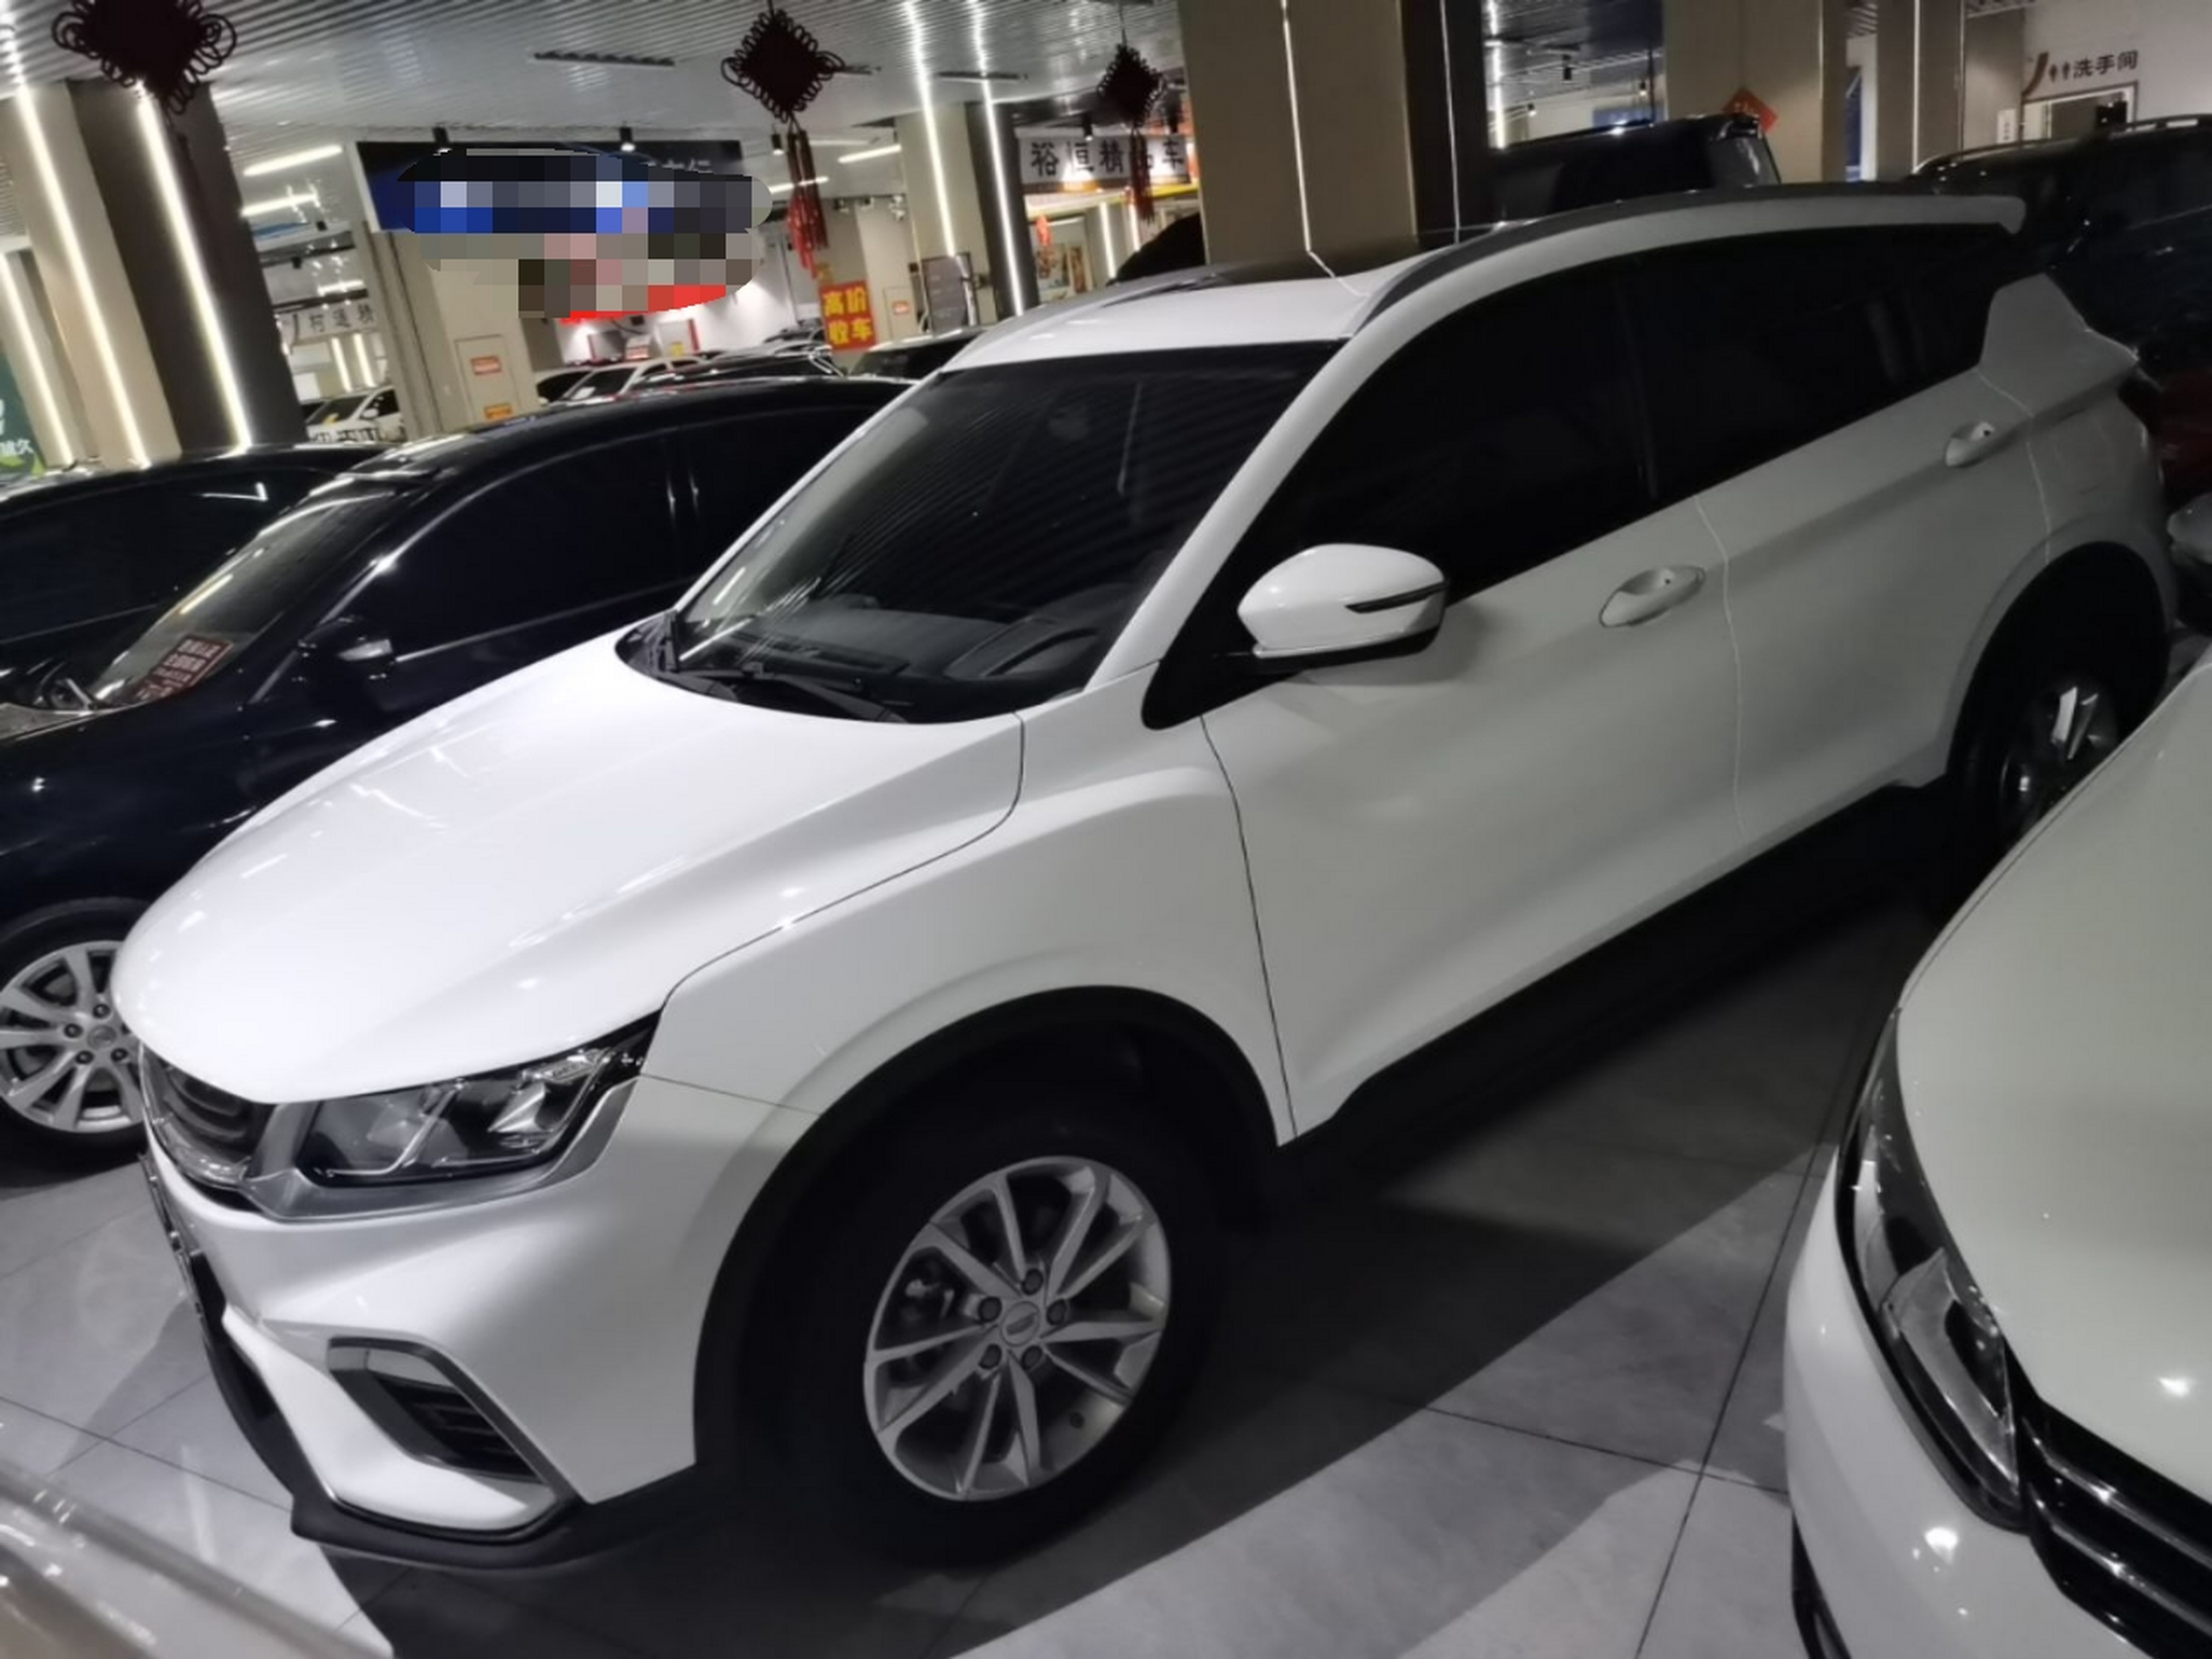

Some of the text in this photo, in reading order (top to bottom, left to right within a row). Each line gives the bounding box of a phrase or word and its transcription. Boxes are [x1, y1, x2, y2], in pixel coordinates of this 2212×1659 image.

[2074, 50, 2138, 79] 洗手间
[822, 287, 866, 317] 高价
[828, 318, 873, 344] 收车
